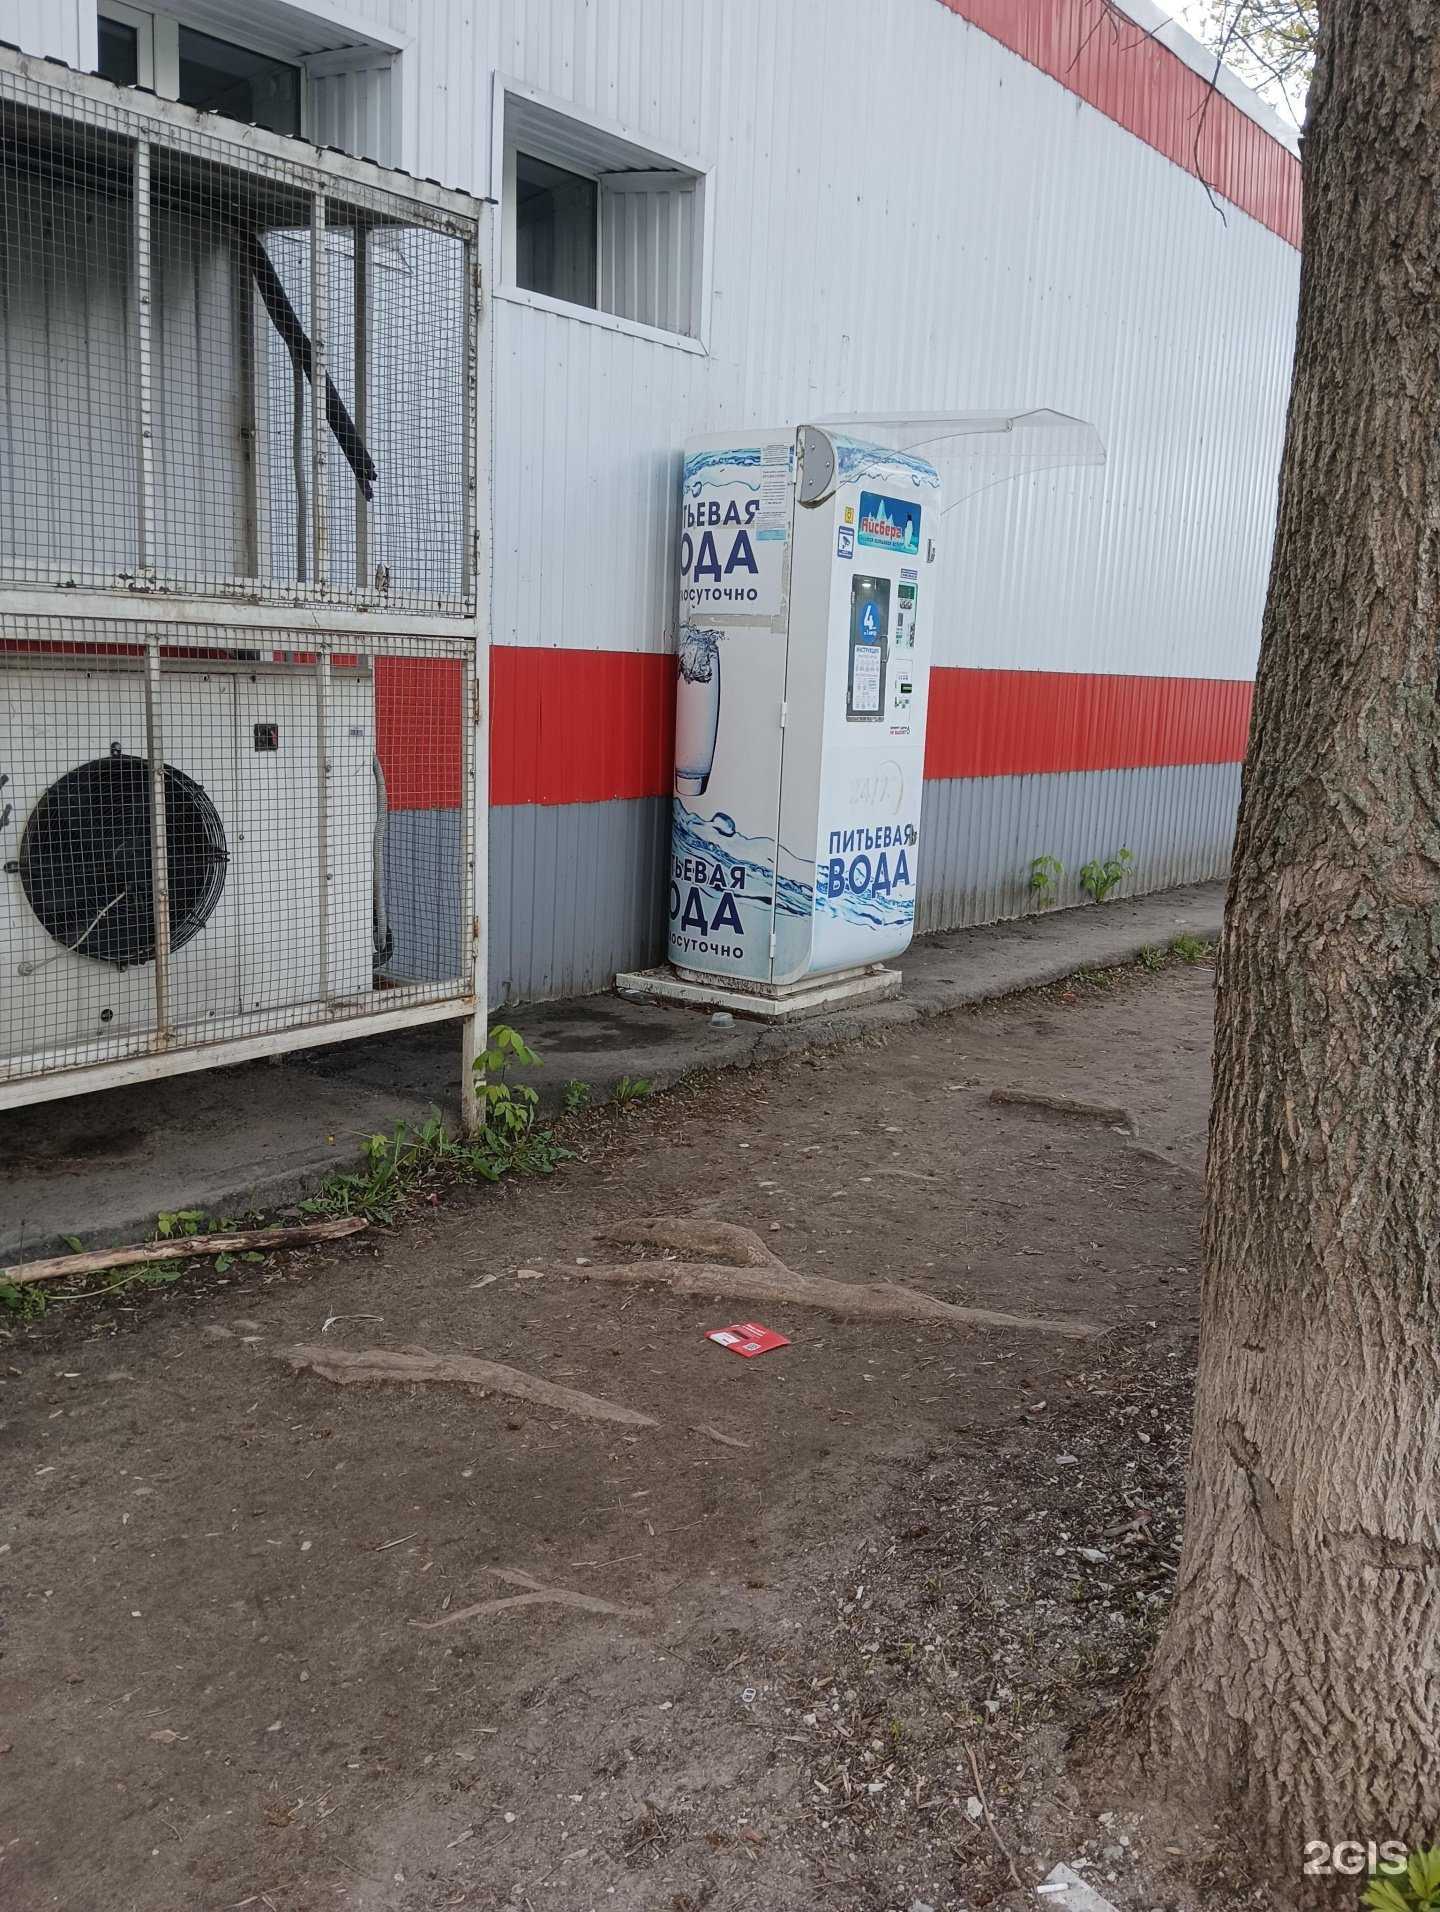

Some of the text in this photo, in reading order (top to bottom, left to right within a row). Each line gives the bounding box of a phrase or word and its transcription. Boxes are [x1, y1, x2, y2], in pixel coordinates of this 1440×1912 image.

[829, 824, 914, 854] ПИТЬЕВАЯ
[828, 849, 910, 898] ВОДА
[670, 931, 743, 959] осуточно
